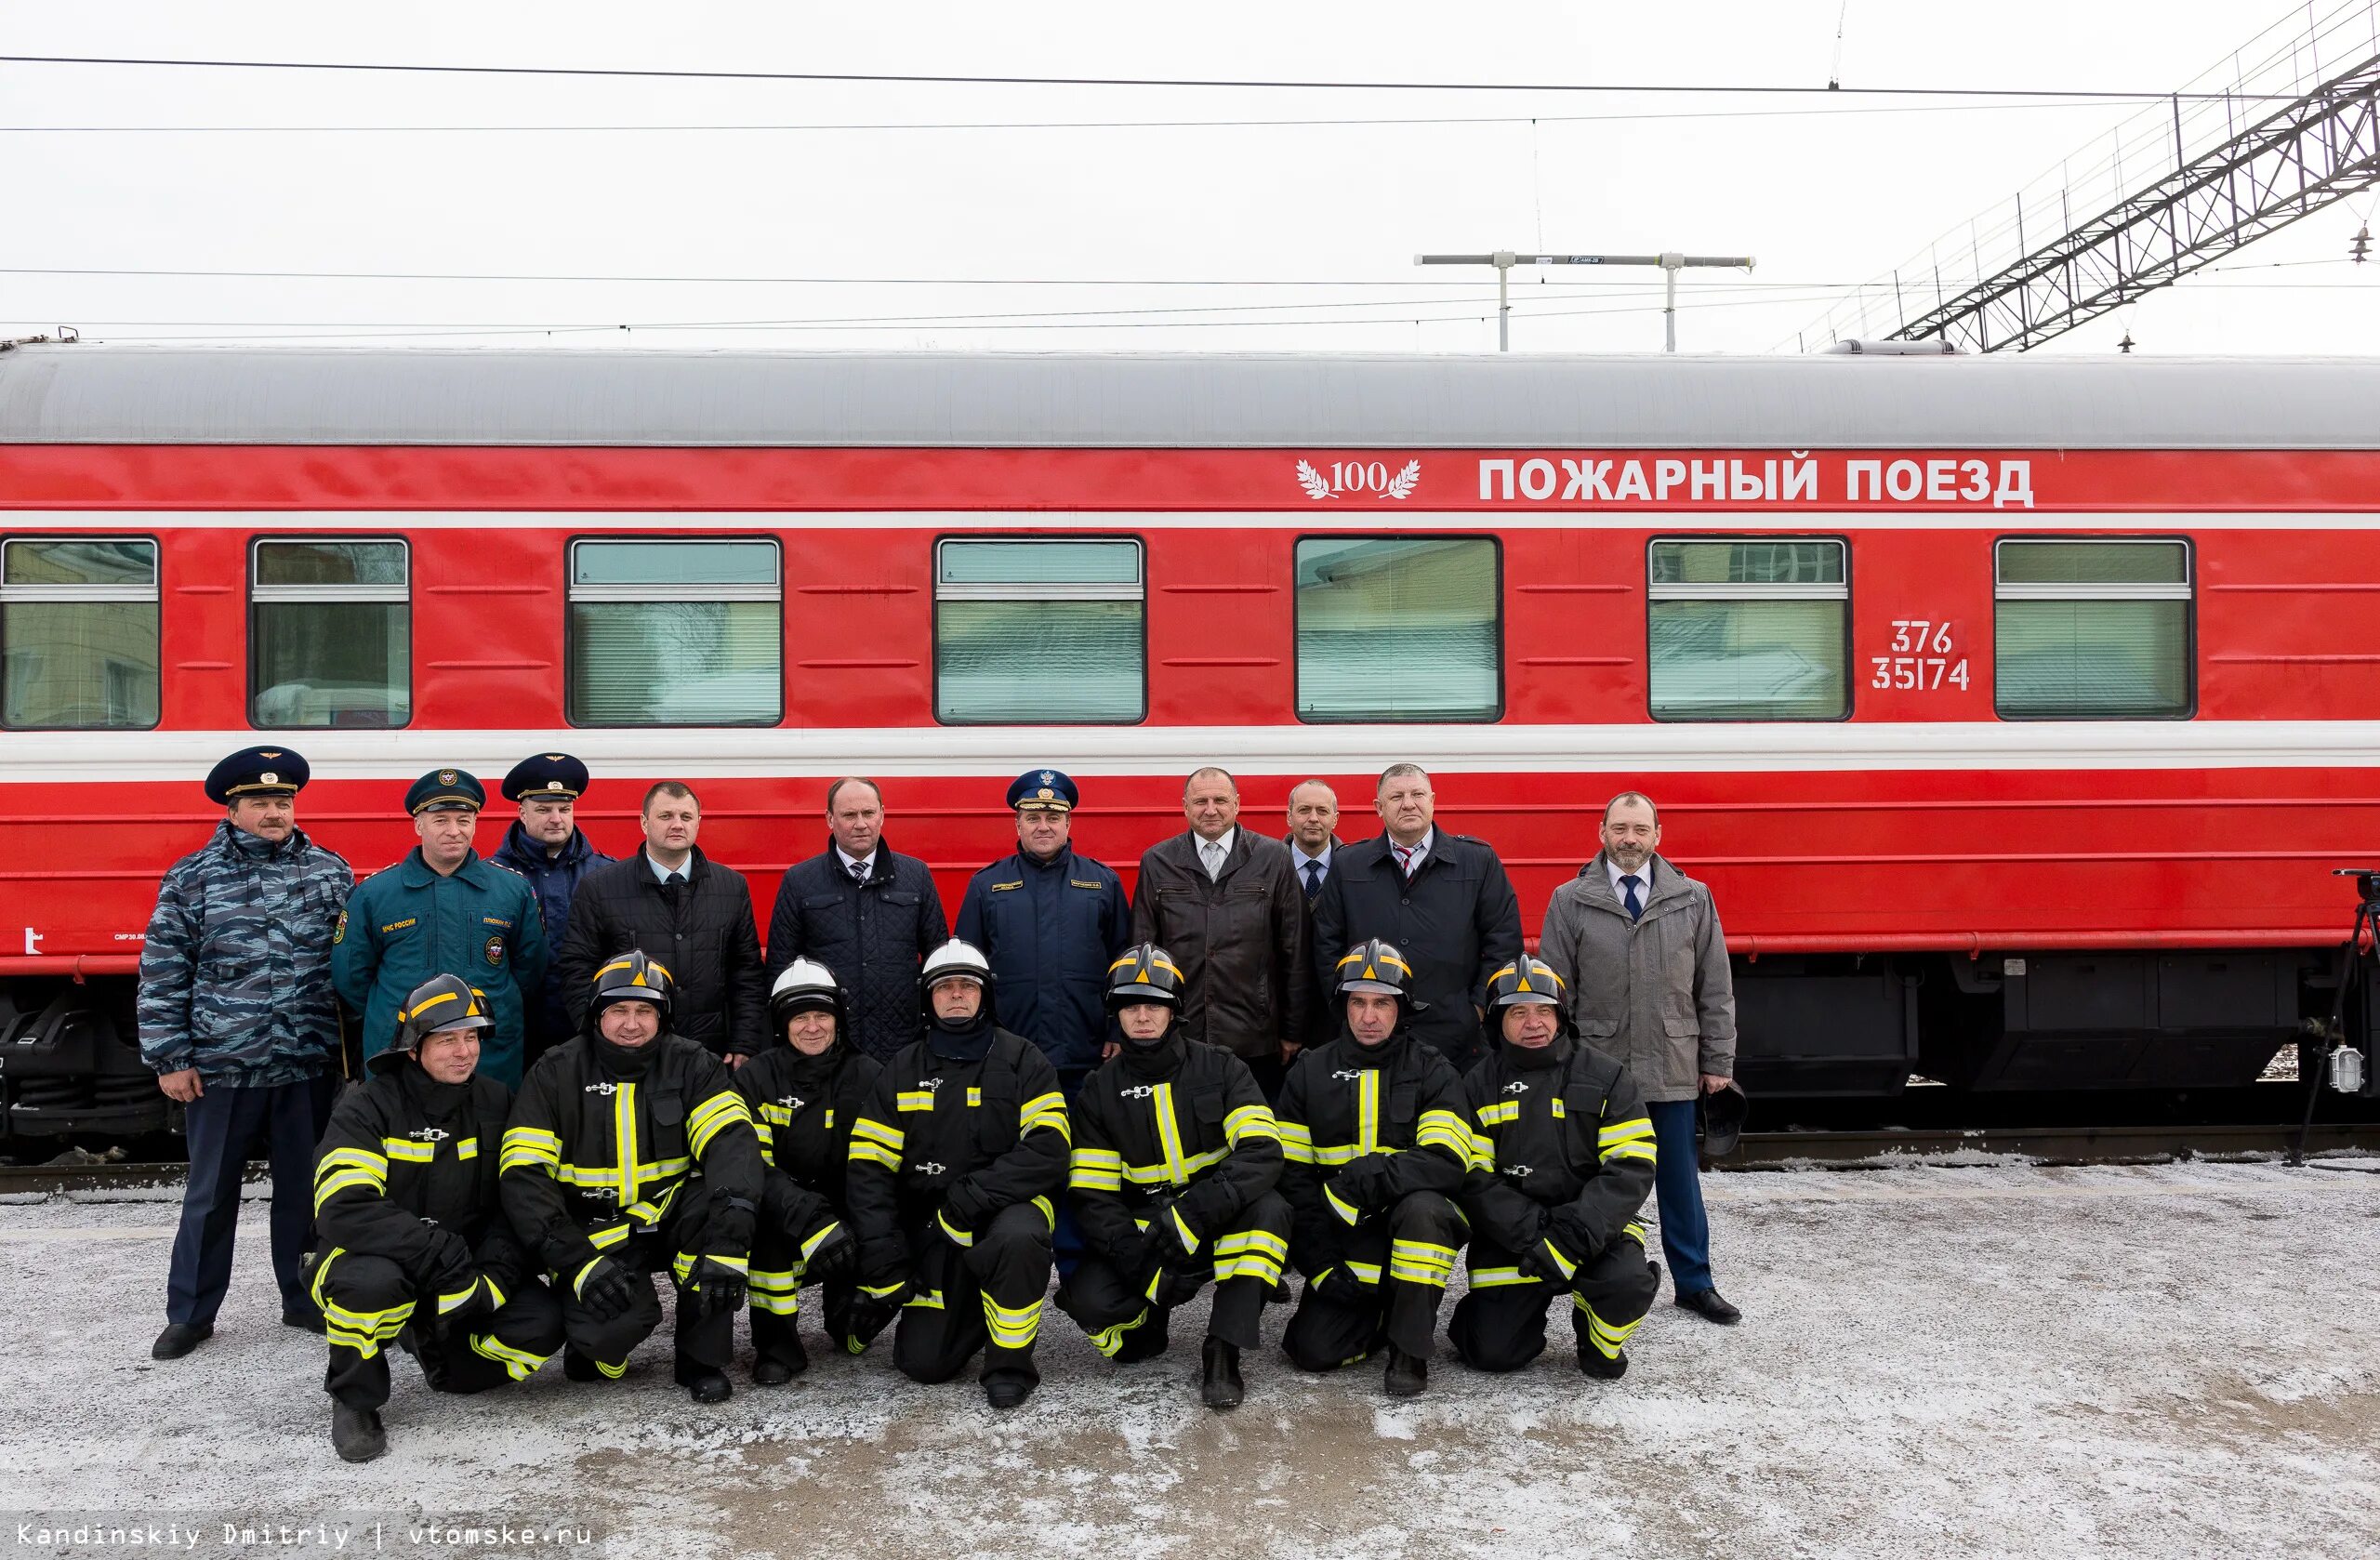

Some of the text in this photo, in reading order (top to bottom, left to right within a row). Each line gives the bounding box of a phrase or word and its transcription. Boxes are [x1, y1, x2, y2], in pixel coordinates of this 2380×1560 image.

[1330, 461, 1388, 492] 100
[1478, 450, 2036, 509] ПОЖАРНЫЙ ПОЕЗД
[1891, 620, 1952, 654] 376
[1871, 656, 1970, 692] 35174
